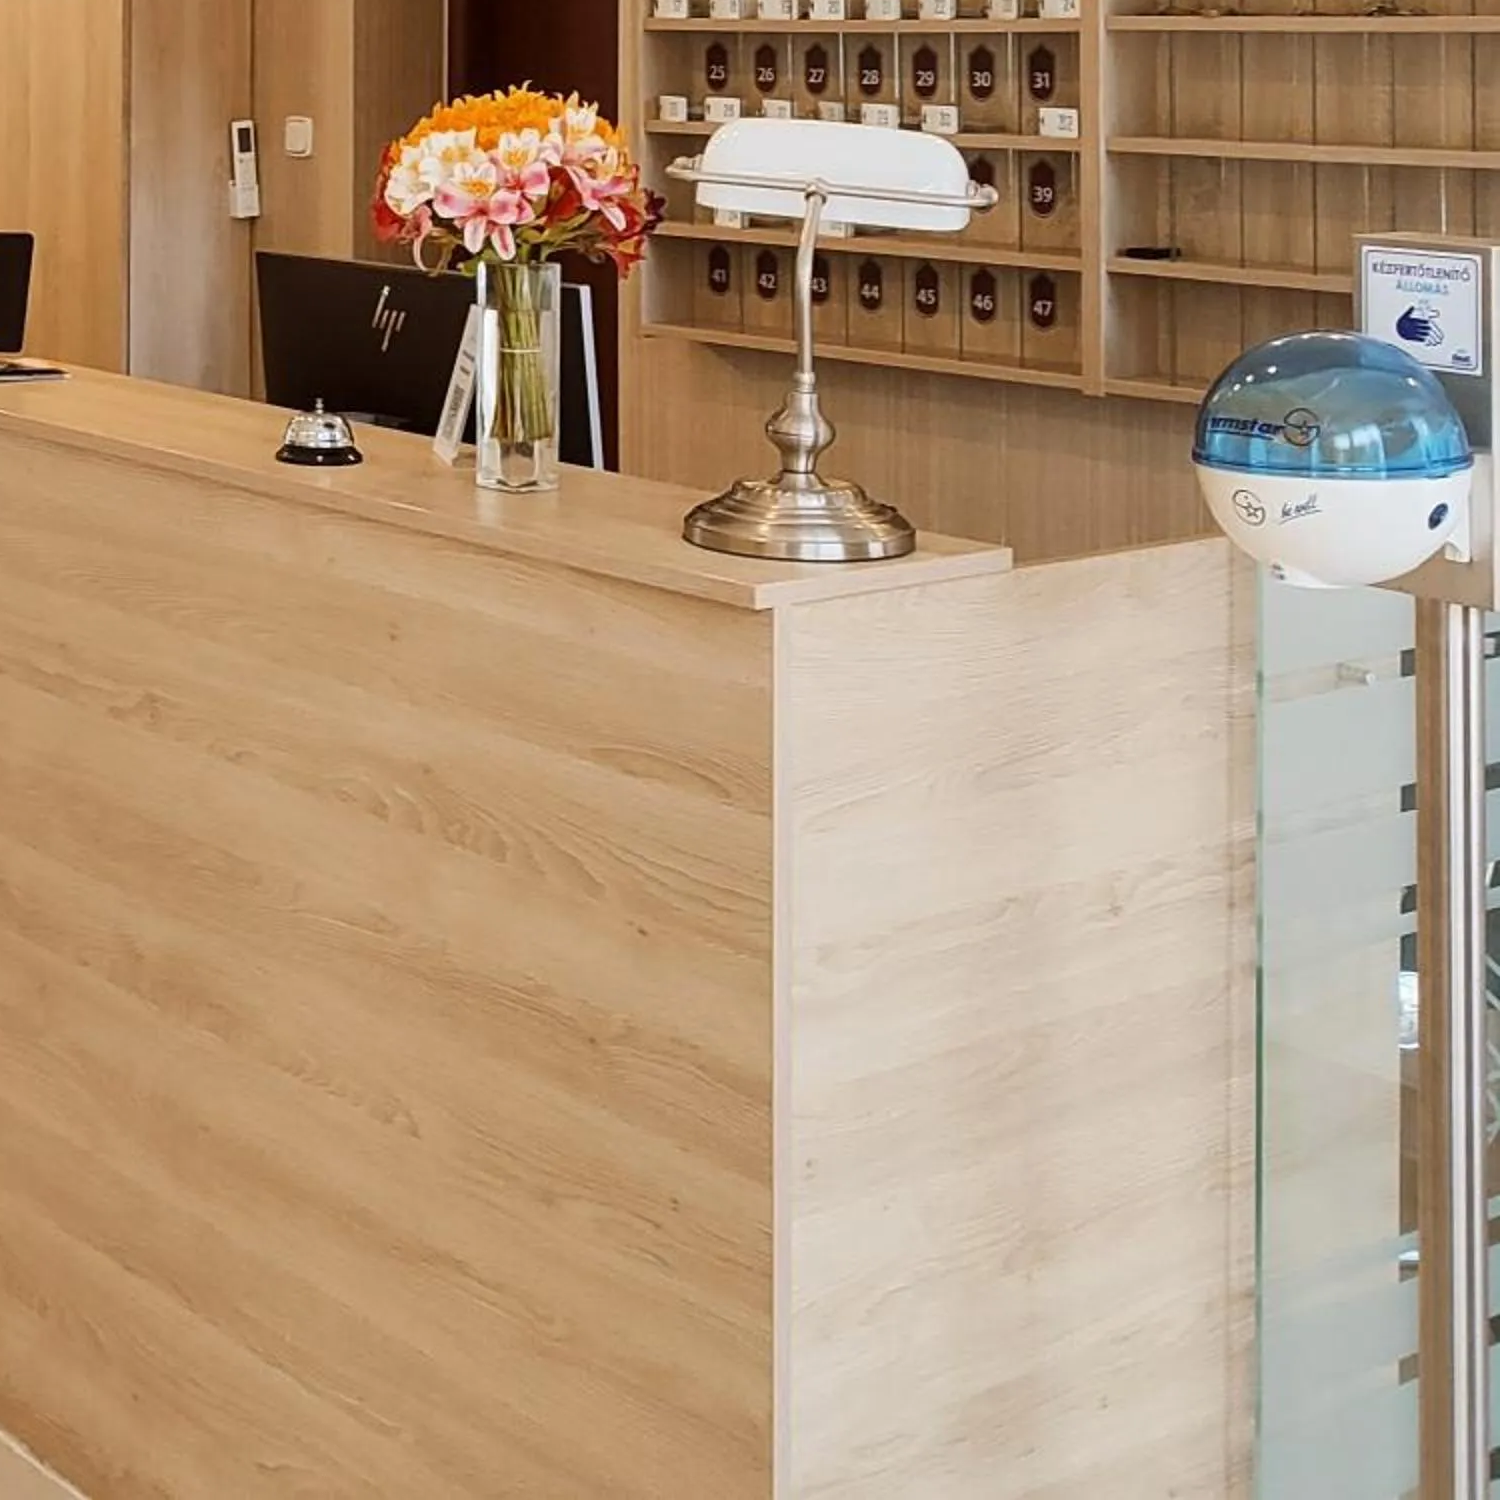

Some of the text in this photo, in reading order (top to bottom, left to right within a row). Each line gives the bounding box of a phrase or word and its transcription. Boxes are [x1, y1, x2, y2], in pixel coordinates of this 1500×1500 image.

[709, 65, 725, 80] 25
[757, 67, 775, 82] 26
[808, 68, 825, 83] 27
[861, 69, 880, 85] 28
[916, 70, 935, 87] 29
[972, 71, 991, 87] 30
[1033, 71, 1050, 89] 31
[1033, 186, 1053, 203] 39
[759, 273, 776, 289] 42
[810, 277, 827, 293] 43
[861, 283, 880, 299] 44
[916, 289, 936, 305] 45
[973, 294, 994, 311] 46
[1033, 300, 1053, 316] 47
